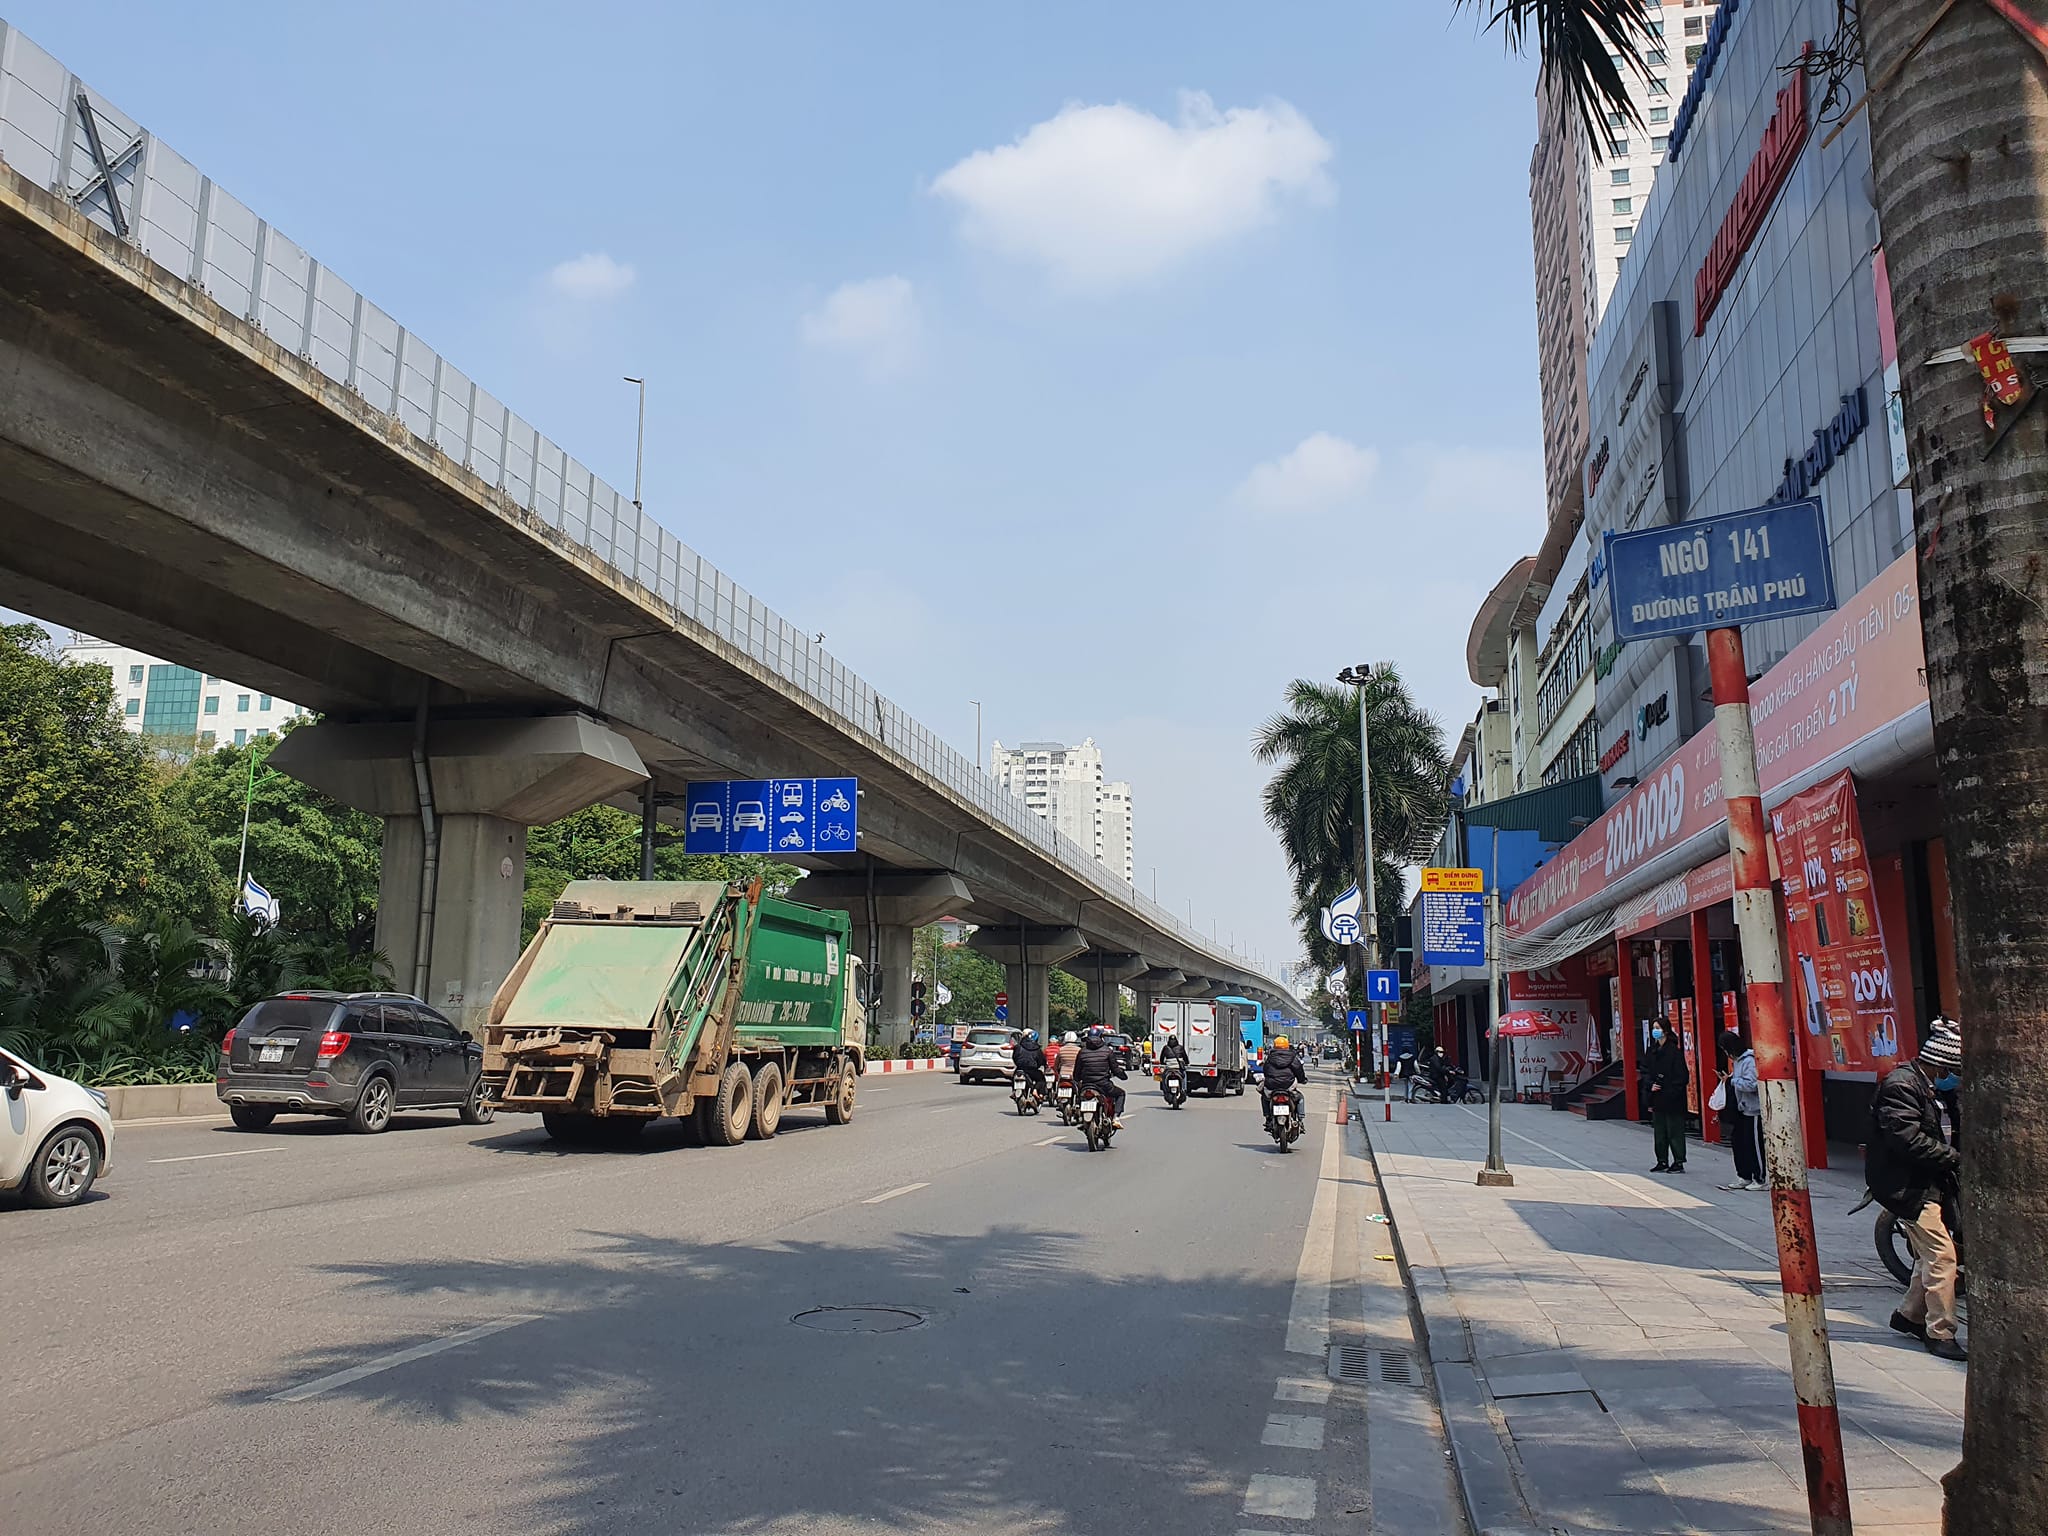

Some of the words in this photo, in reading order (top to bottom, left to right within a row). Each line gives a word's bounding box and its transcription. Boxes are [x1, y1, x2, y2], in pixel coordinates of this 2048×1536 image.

[1659, 529, 1710, 577] NGÕ
[1728, 525, 1771, 564] 141
[1631, 595, 1700, 624] ĐƯỜNG
[1704, 581, 1759, 612] TRẦN
[1763, 572, 1807, 602] PHÚ
[1775, 670, 1804, 709] KHÁCH
[1805, 646, 1833, 687] HÀNG
[1834, 620, 1857, 665] ĐẦU
[1858, 603, 1884, 646] TIÊN
[1775, 722, 1790, 759] GIÁ
[1791, 718, 1805, 750] TRỊ
[1806, 699, 1826, 740] ĐẾN
[1828, 688, 1837, 726] 2
[1839, 660, 1859, 718] TỶ
[1604, 762, 1685, 877] 200.000Đ
[1803, 855, 1827, 889] 10%
[1850, 966, 1893, 1002] 20%
[1512, 1018, 1531, 1028] NK
[1557, 1010, 1578, 1025] XE
